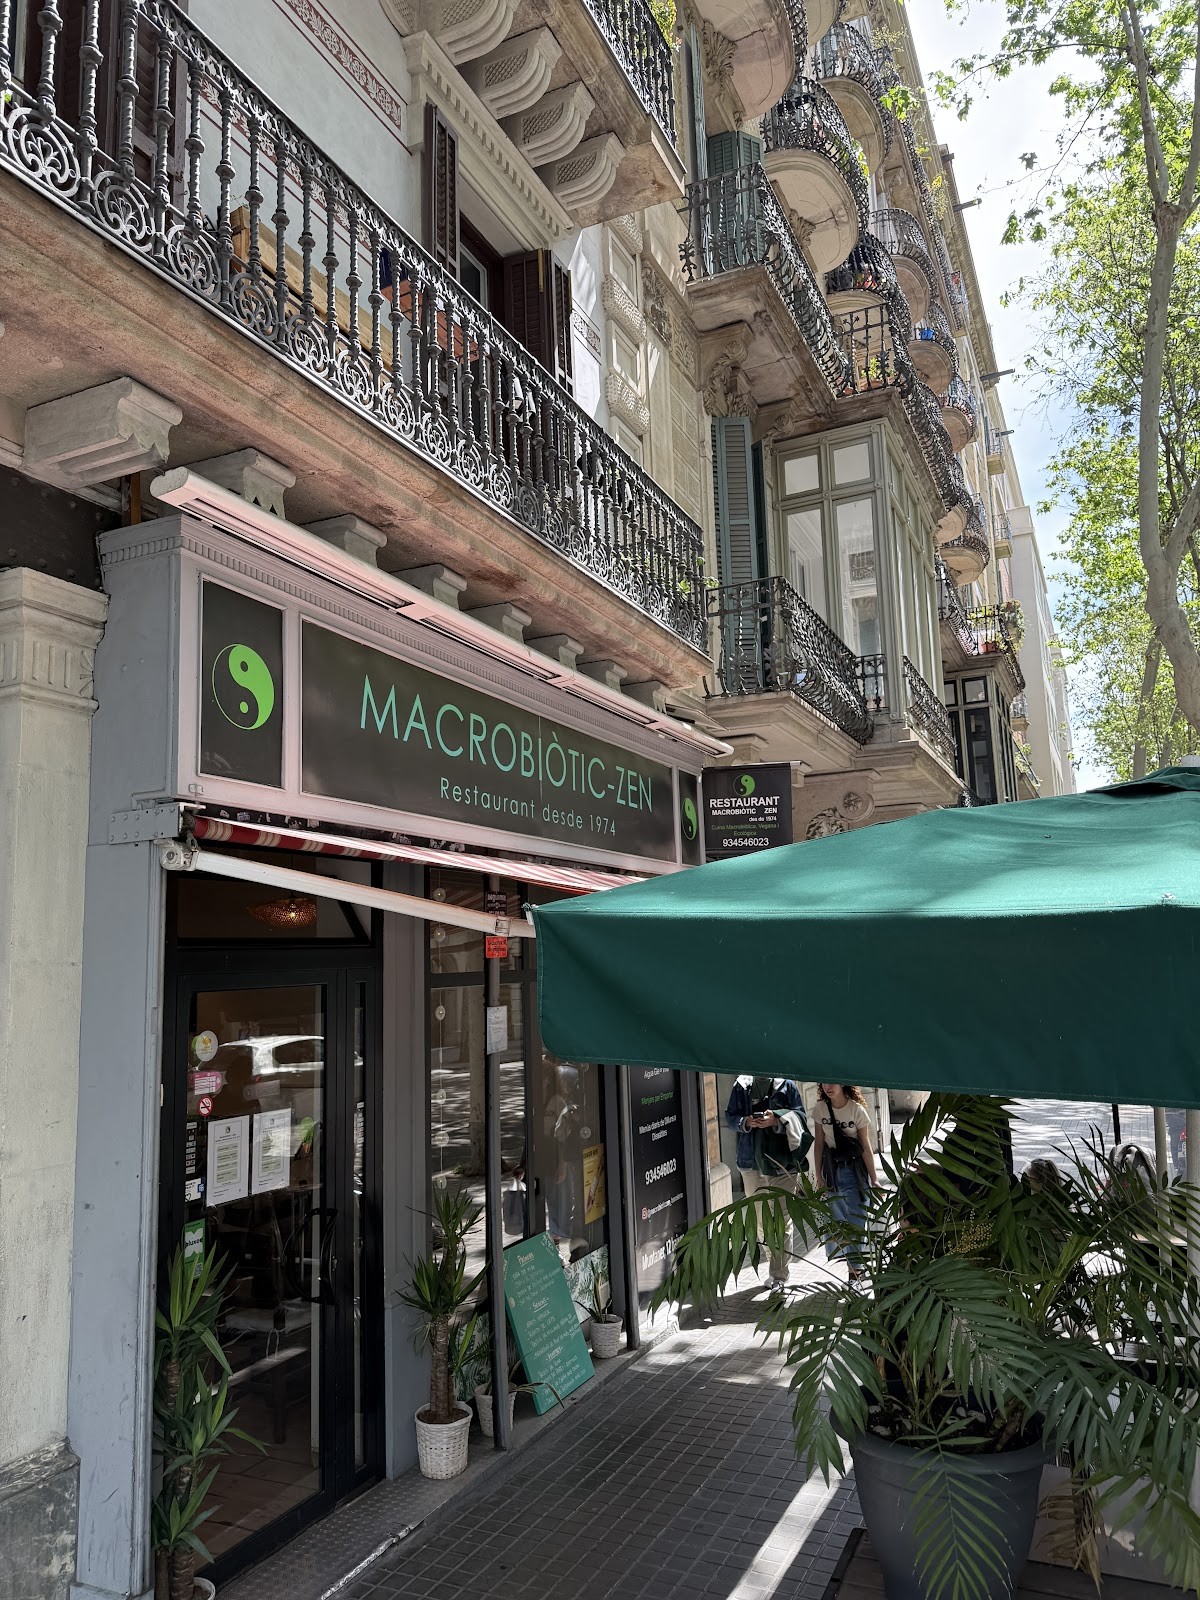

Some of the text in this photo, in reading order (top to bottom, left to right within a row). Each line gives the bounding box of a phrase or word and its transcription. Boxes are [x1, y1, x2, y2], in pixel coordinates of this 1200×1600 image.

[361, 674, 652, 813] MACROBIÒTIC-ZEN
[440, 777, 616, 836] Restaurant desde 1974
[709, 796, 780, 808] RESTAURANT
[722, 838, 769, 847] 934546023
[645, 1158, 676, 1185] 934546023
